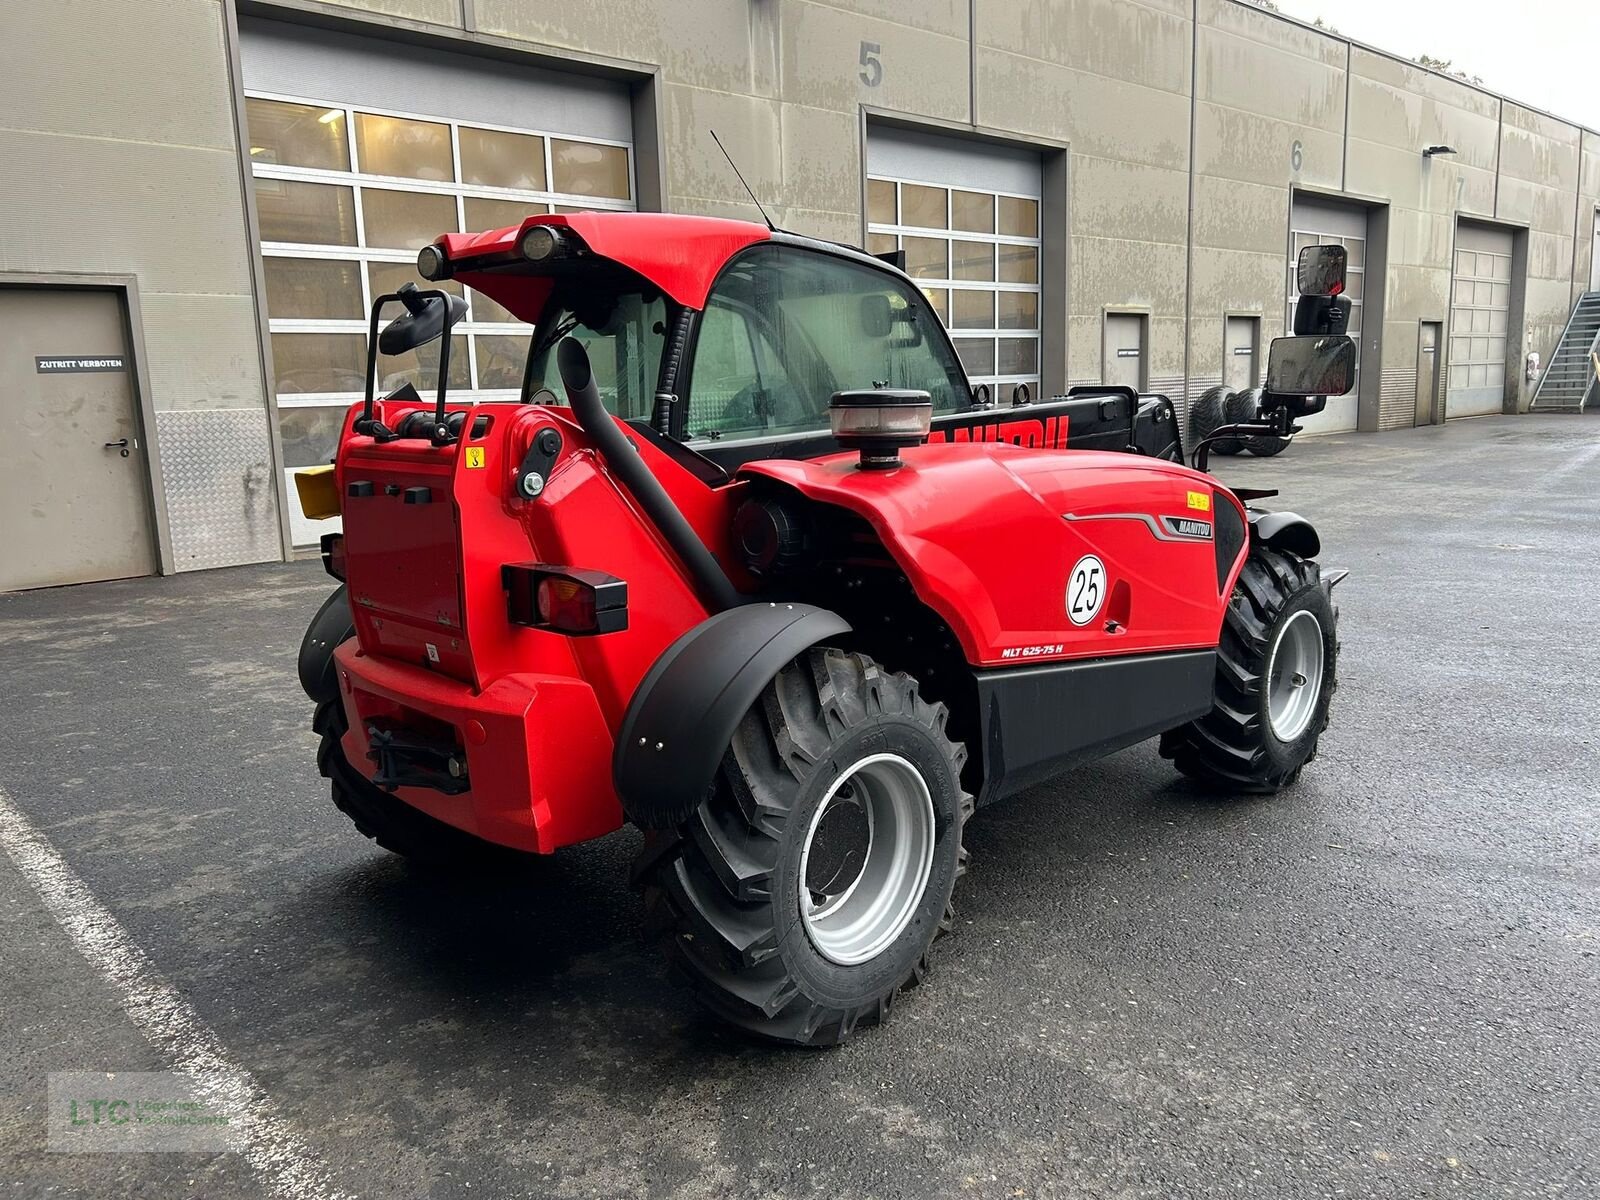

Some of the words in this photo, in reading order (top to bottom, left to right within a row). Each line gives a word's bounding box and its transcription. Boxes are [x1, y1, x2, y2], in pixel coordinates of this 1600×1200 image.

[859, 40, 882, 87] 5
[1291, 139, 1303, 171] 6
[1457, 176, 1465, 202] 7
[39, 360, 77, 369] ZUTRITT
[78, 359, 123, 368] VERBOTEN
[1178, 520, 1211, 536] MANITOU
[1072, 568, 1099, 613] 25
[1001, 647, 1022, 659] MLT
[1022, 645, 1055, 656] 625-75
[1055, 644, 1064, 654] H
